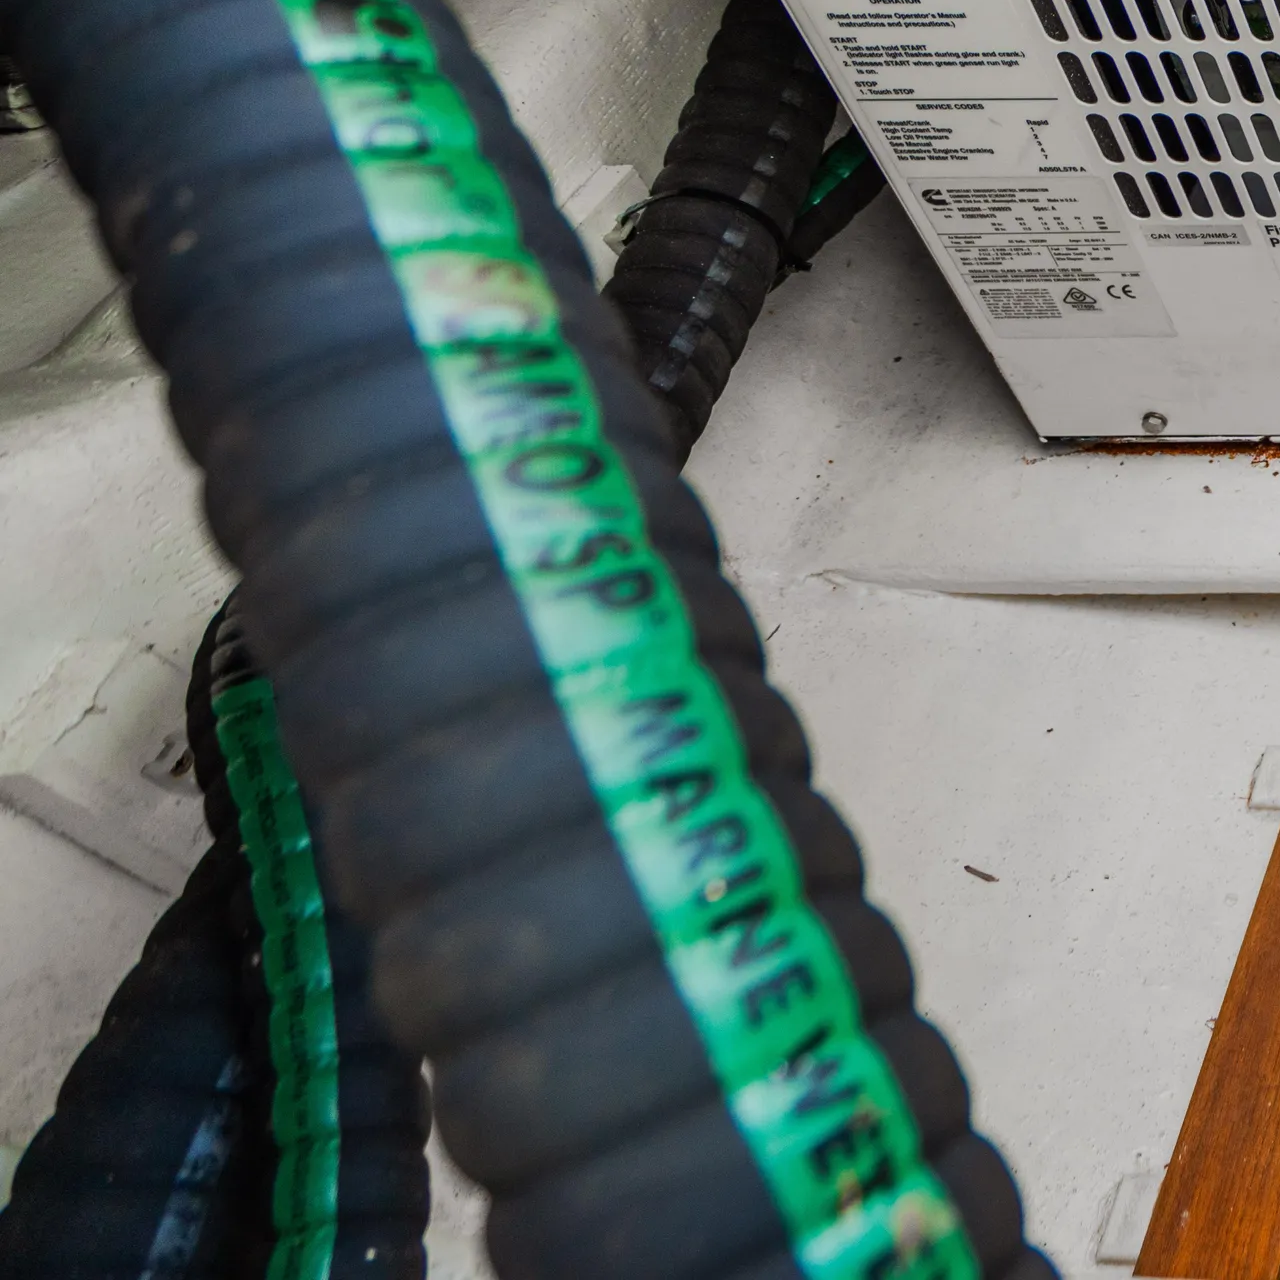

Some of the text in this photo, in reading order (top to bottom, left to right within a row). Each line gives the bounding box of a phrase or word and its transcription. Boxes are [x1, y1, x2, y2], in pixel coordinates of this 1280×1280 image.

[904, 21, 955, 29] precautions.)
[1002, 60, 1019, 68] light
[881, 127, 900, 135] High
[932, 127, 952, 135] Temp
[932, 148, 959, 156] Engine
[960, 148, 995, 156] Cranking
[619, 688, 819, 1033] MARINE
